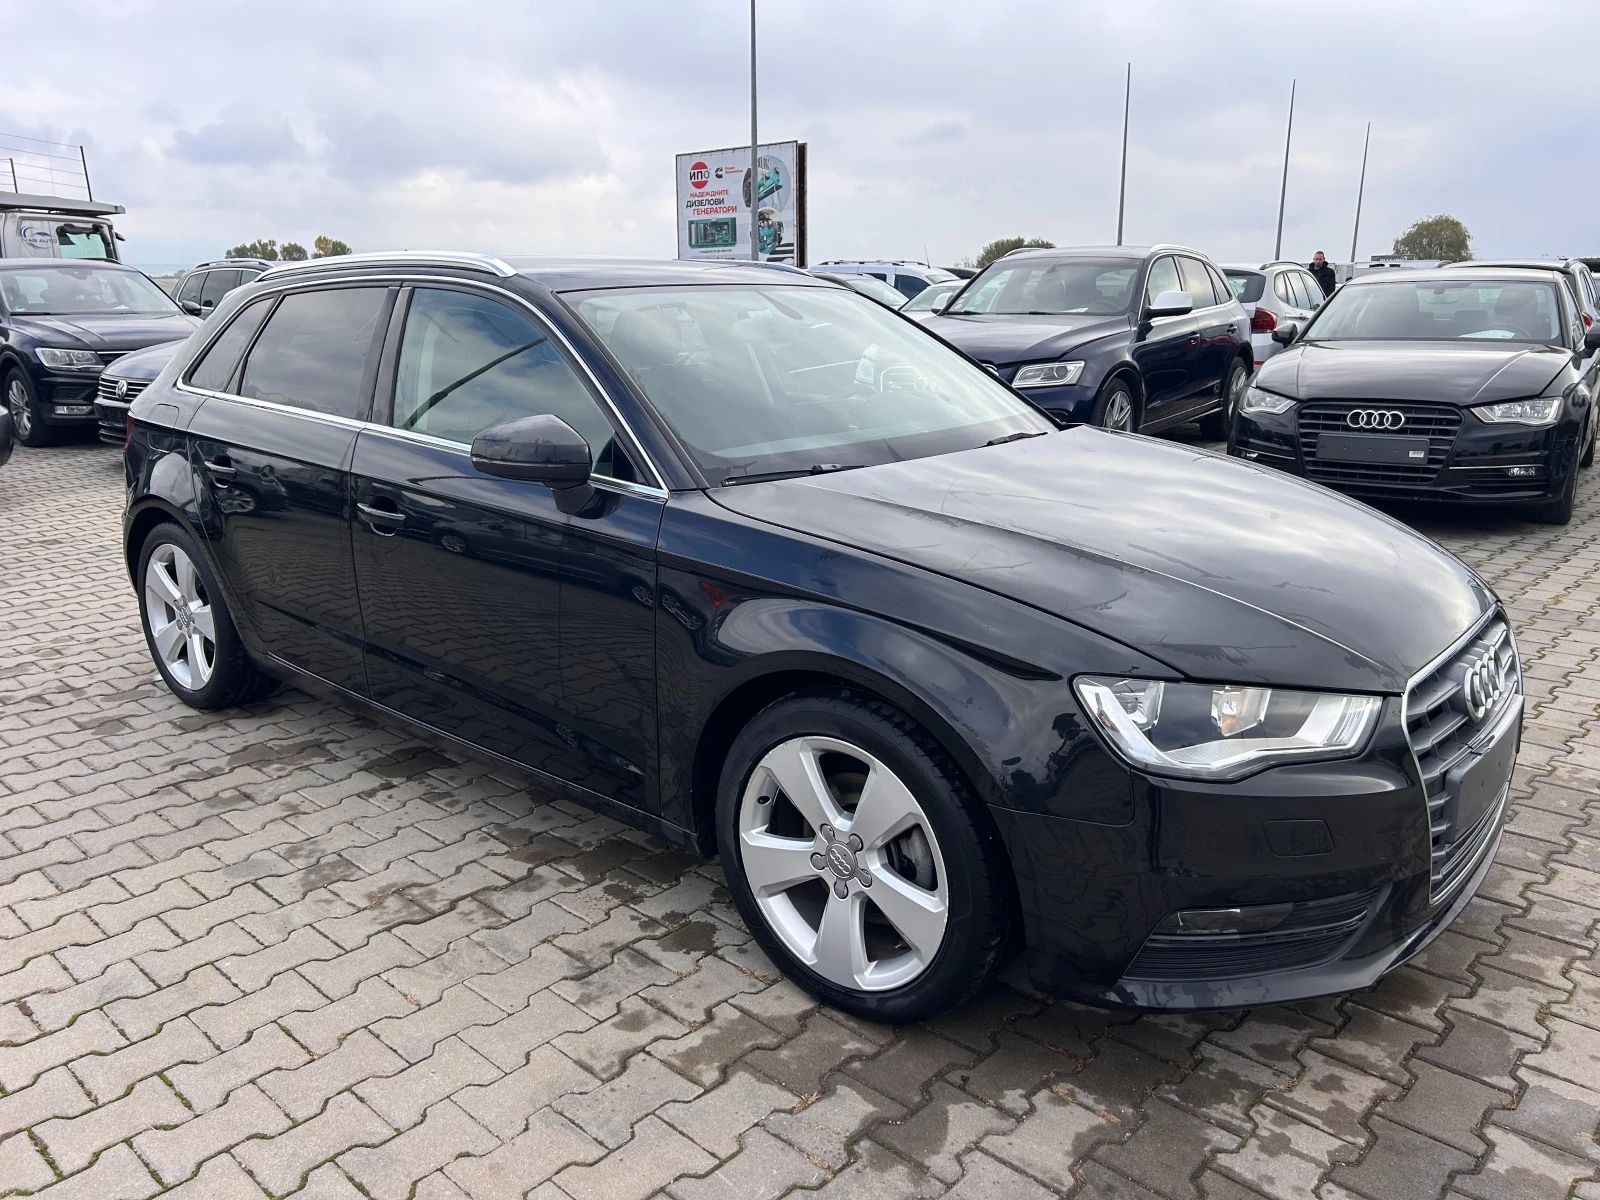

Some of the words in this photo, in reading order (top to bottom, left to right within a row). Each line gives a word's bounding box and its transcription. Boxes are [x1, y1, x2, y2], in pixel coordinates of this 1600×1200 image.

[689, 169, 710, 181] ИПО
[689, 189, 729, 198] НАДЕЖДНИТЕ
[686, 198, 724, 209] ДИЗЕЛОВИ
[693, 205, 737, 215] ГЕНЕРАТОРИ
